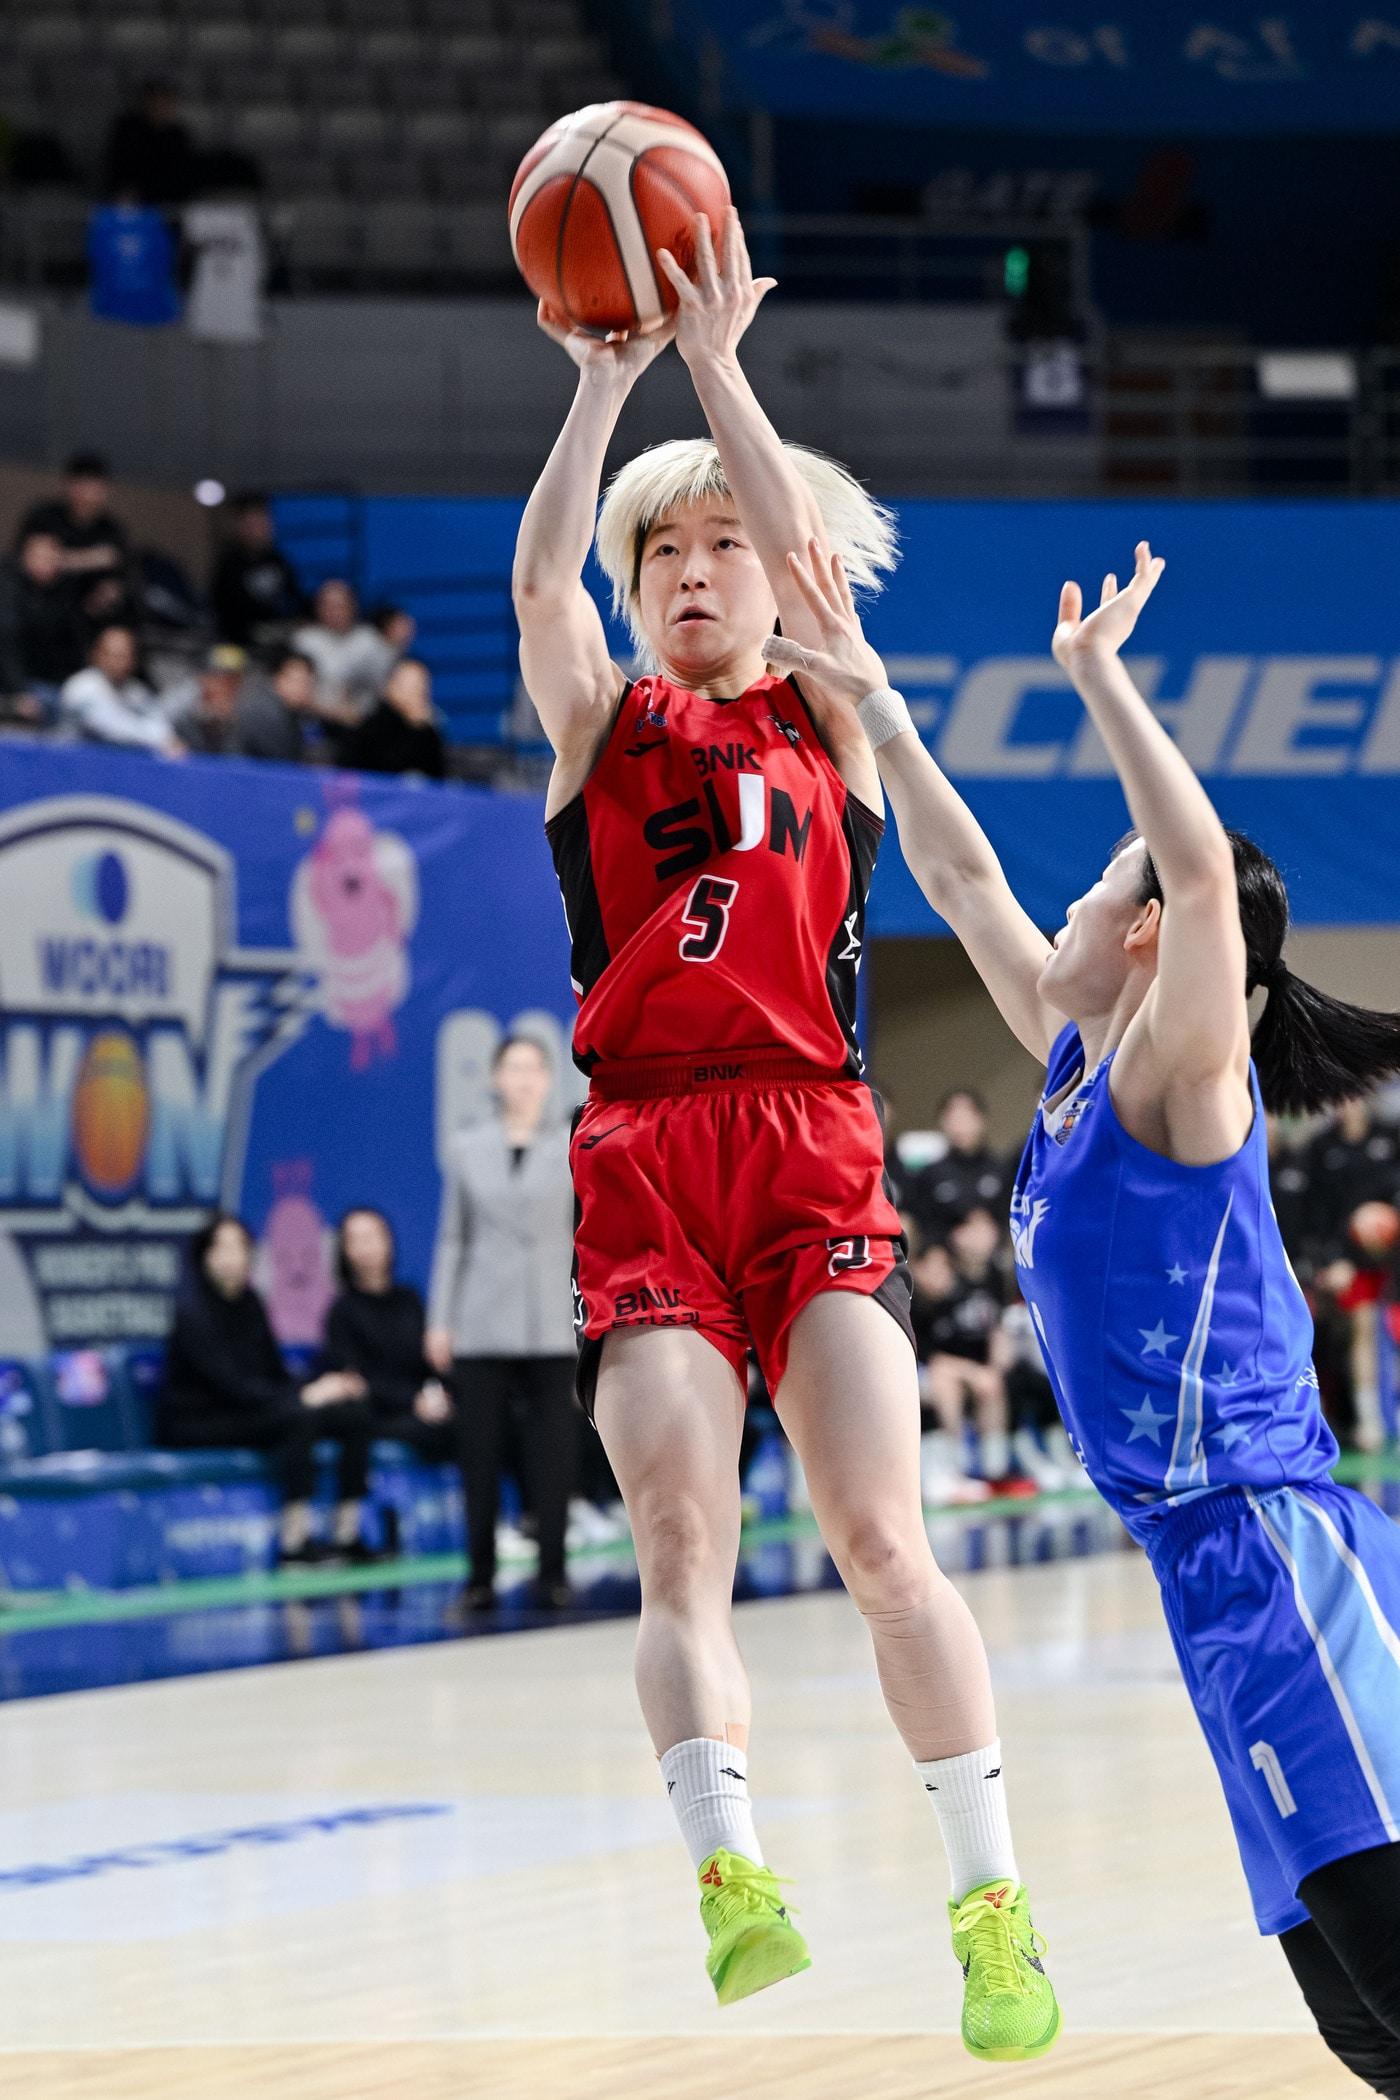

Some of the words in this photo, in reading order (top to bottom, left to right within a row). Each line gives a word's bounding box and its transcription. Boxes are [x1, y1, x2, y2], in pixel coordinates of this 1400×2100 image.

[690, 743, 763, 776] BNK
[679, 874, 739, 962] 5
[694, 1064, 746, 1082] BNK
[1248, 1739, 1298, 1819] 1
